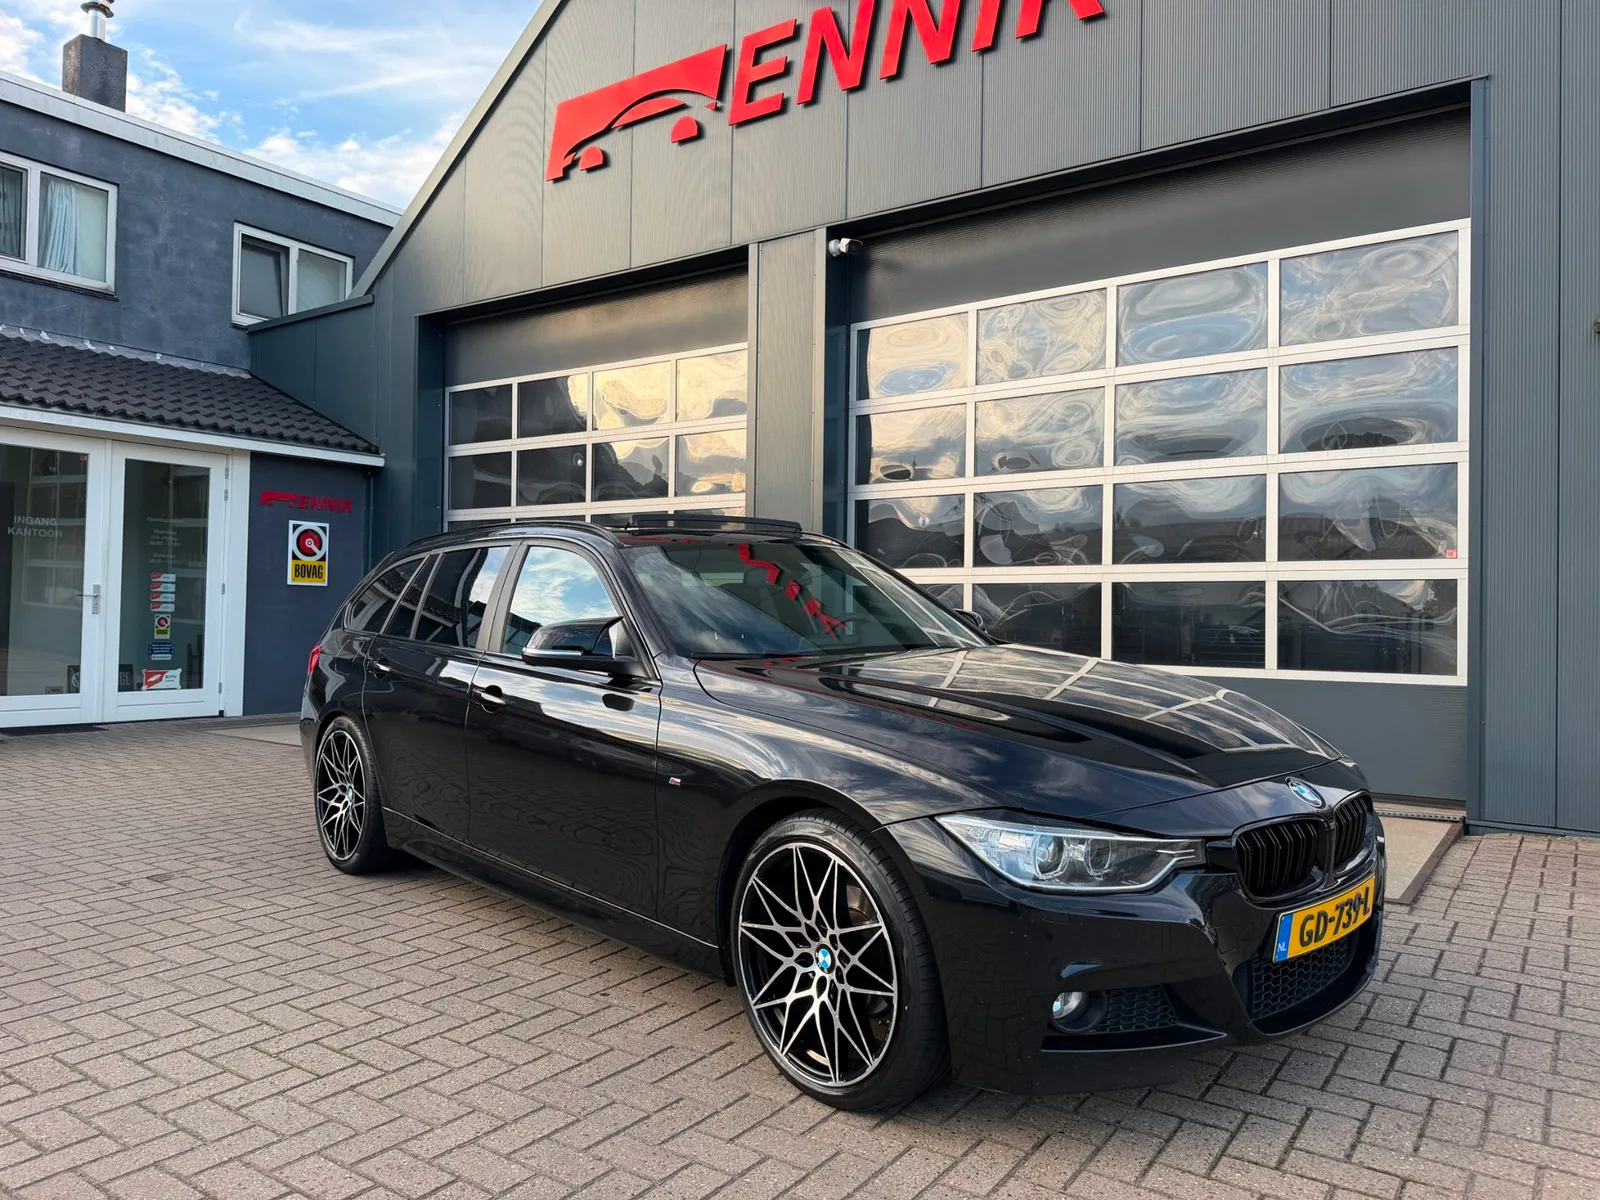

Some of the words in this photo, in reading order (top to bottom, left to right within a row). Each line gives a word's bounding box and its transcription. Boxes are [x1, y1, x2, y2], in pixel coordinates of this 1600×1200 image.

[14, 515, 58, 526] INGANG
[7, 527, 63, 538] KANTOOR
[294, 563, 323, 579] BOVAG
[1299, 886, 1371, 948] GD-739-L
[1277, 941, 1287, 953] NL
